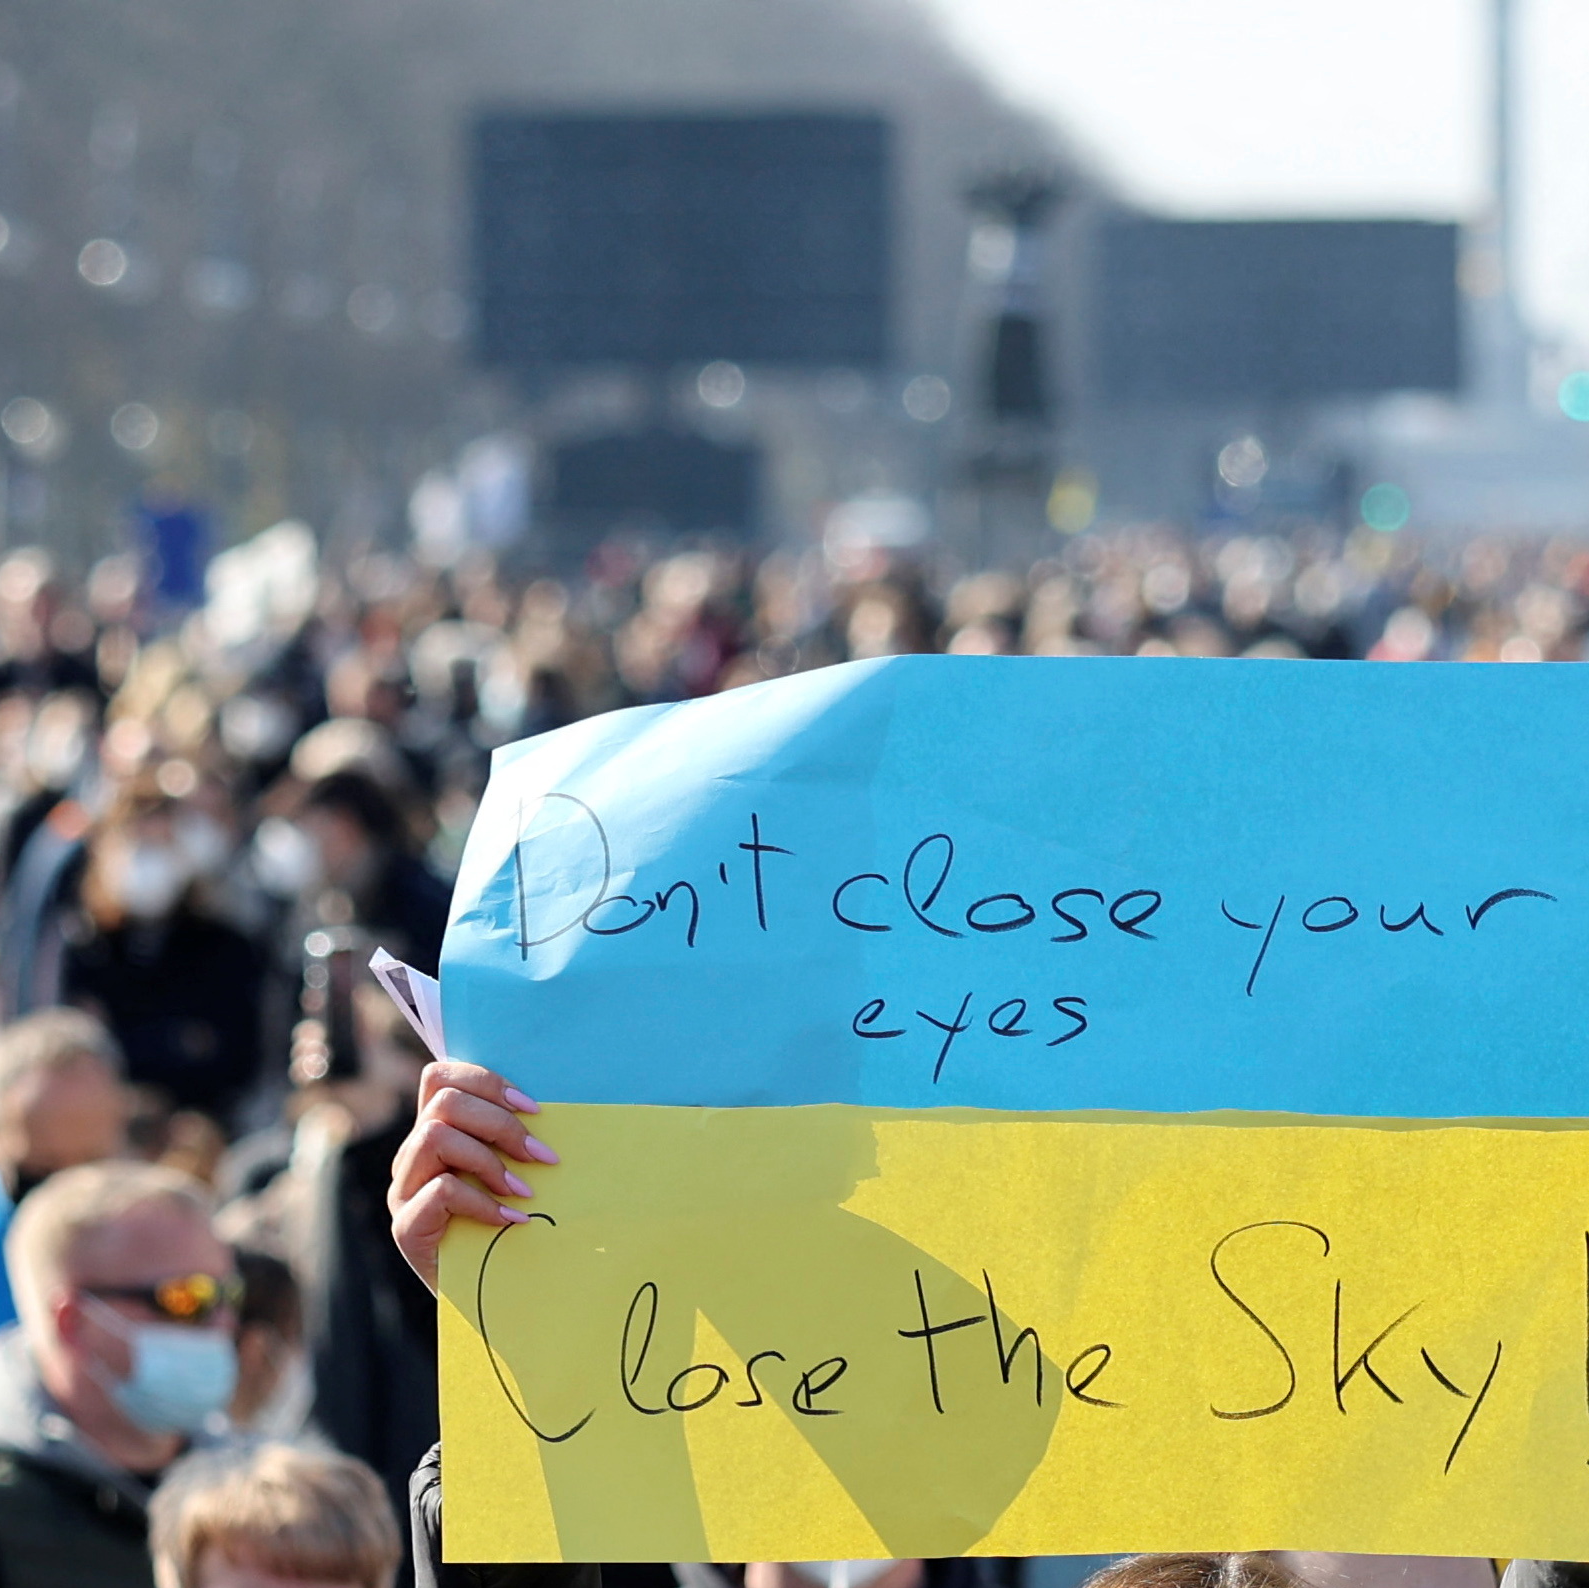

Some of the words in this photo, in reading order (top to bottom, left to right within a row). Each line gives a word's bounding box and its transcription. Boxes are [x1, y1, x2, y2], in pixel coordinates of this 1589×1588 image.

[517, 791, 798, 962] Don't
[833, 832, 1162, 943] close
[1220, 887, 1559, 997] your
[850, 992, 1091, 1084] eyes
[476, 1212, 848, 1443] Close
[896, 1267, 1128, 1413] the
